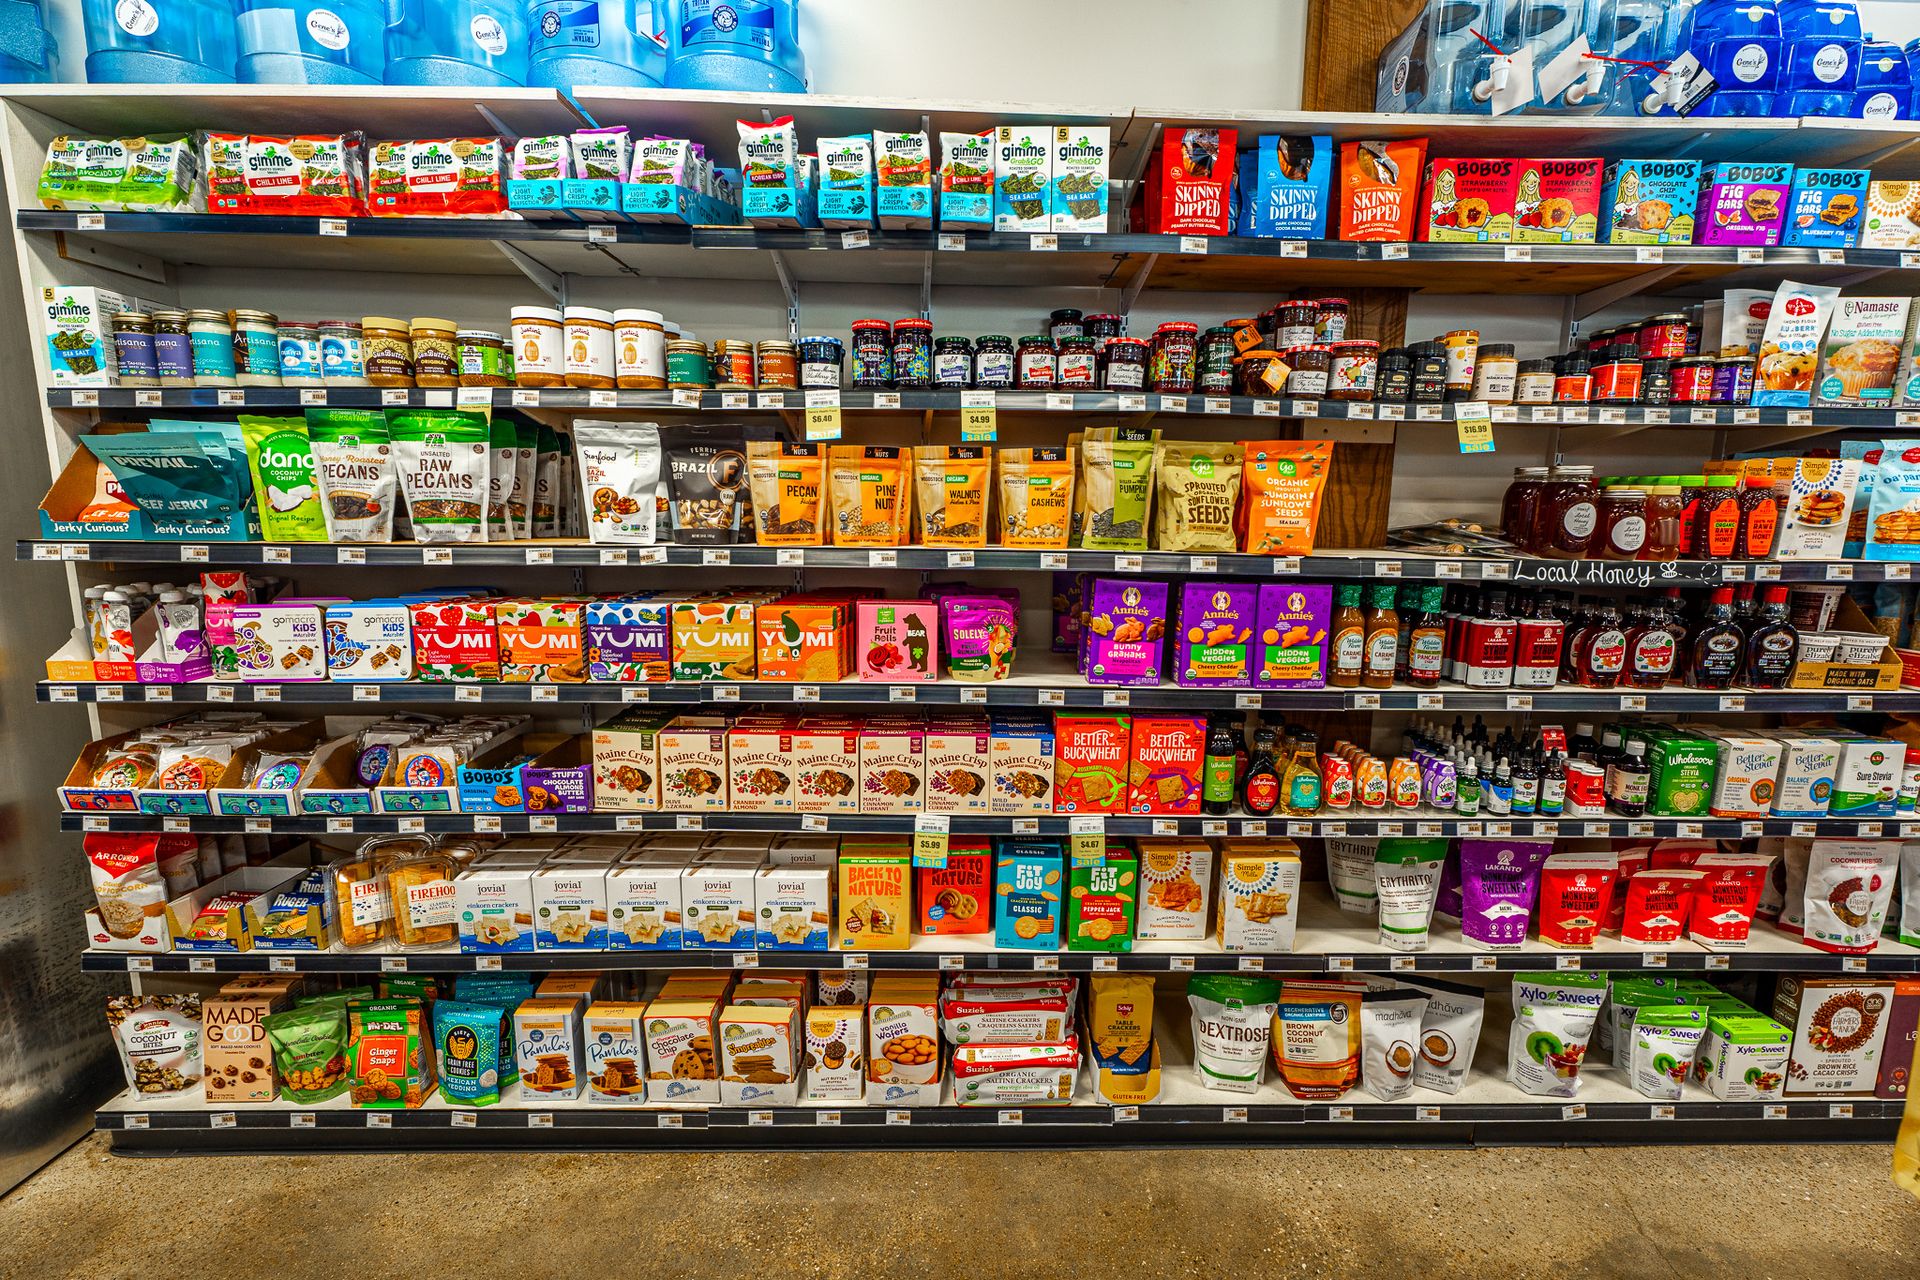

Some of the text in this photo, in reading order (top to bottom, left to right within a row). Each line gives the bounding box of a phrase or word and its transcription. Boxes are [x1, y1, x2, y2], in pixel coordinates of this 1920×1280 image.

[523, 140, 559, 154] gimme
[746, 142, 784, 155] gimme
[886, 138, 922, 150] gimme
[581, 148, 618, 159] gimme
[642, 147, 678, 158] gimme
[827, 152, 863, 165] gimme
[952, 147, 988, 159] gimme
[1002, 146, 1045, 160] gimme
[1060, 146, 1102, 160] gimme
[249, 154, 293, 169] gimme
[412, 153, 452, 169] gimme
[1457, 161, 1512, 177] BOBO'S
[1541, 162, 1598, 176] BOBO'S
[1641, 163, 1694, 178] BOBO'S
[1728, 165, 1786, 182] BOBO'S
[1806, 171, 1861, 188] BOBO'S
[1882, 182, 1907, 190] Simple
[1175, 186, 1221, 201] SKINNY
[1271, 189, 1318, 204] SKINNY
[1354, 192, 1401, 208] SKINNY
[1718, 199, 1743, 209] BARS
[1174, 202, 1221, 217] DIPPED
[1270, 205, 1316, 221] DIPPED
[1796, 205, 1821, 214] BARS
[1353, 208, 1400, 224] DIPPED
[48, 303, 90, 317] gimme
[1854, 301, 1899, 313] Namaste
[812, 415, 832, 423] $6.40
[969, 415, 989, 424] $4.99
[1464, 425, 1487, 433] $16.99
[967, 432, 991, 441] sale
[419, 459, 451, 472] RAW
[672, 462, 716, 473] BRAZIL
[322, 466, 379, 480] PECANS
[407, 474, 472, 489] PECANS
[1185, 482, 1226, 492] SPROUTED
[1266, 478, 1309, 486] ORGANIC
[787, 485, 818, 497] PECAN
[876, 485, 896, 496] PINE
[950, 490, 980, 499] WALNUTS
[167, 499, 208, 511] JERKY
[875, 498, 894, 509] NUTS
[1031, 499, 1065, 507] CASHEWS
[1188, 497, 1229, 505] SUNFLOWER
[1189, 506, 1229, 524] SEEDS
[1275, 508, 1303, 516] SEEDS
[54, 523, 129, 533] Jerky Curious?
[154, 524, 230, 535] Jerky Curious?
[1514, 561, 1655, 587] Local Honey
[1112, 606, 1149, 616] Annie's
[1203, 611, 1239, 620] Annie's
[1278, 611, 1314, 621] Annie's
[874, 626, 896, 634] Fruit
[908, 629, 925, 637] BEAR
[954, 629, 982, 639] SOLELY
[418, 632, 491, 648] YUMI
[503, 632, 578, 649] YUMI
[592, 632, 664, 648] YUMI
[677, 632, 751, 646] YUMI
[762, 632, 833, 646] YUMI
[874, 634, 896, 642] Rolls
[1218, 663, 1238, 671] Cheddar
[1828, 669, 1867, 677] MADE WITH
[1074, 731, 1109, 747] BETTER
[596, 750, 653, 765] Maine Crisp
[1064, 746, 1121, 761] BUCKWHEAT
[1140, 748, 1196, 762] BUCKWHEAT
[929, 754, 988, 768] Maine Crisp
[464, 770, 514, 784] BOBO'S
[552, 771, 583, 779] STUFF'D
[1856, 771, 1893, 781] Sure Stevia
[920, 840, 940, 849] $5.99
[1081, 840, 1099, 849] $4.67
[917, 858, 942, 867] sale
[1486, 864, 1522, 872] LAKANTO
[849, 867, 902, 882] BACK TO
[554, 881, 582, 892] jovial
[778, 882, 805, 892] jovial
[849, 881, 901, 896] NATURE
[209, 899, 243, 911] RUGER
[274, 895, 308, 908] RUGER
[1013, 906, 1042, 914] CLASSIC
[207, 1008, 266, 1024] MADE
[956, 1006, 984, 1014] Suzie's
[207, 1026, 266, 1042] GOOD
[370, 1048, 397, 1058] Ginger
[519, 1037, 570, 1060] Pamela's
[370, 1057, 396, 1066] Snaps
